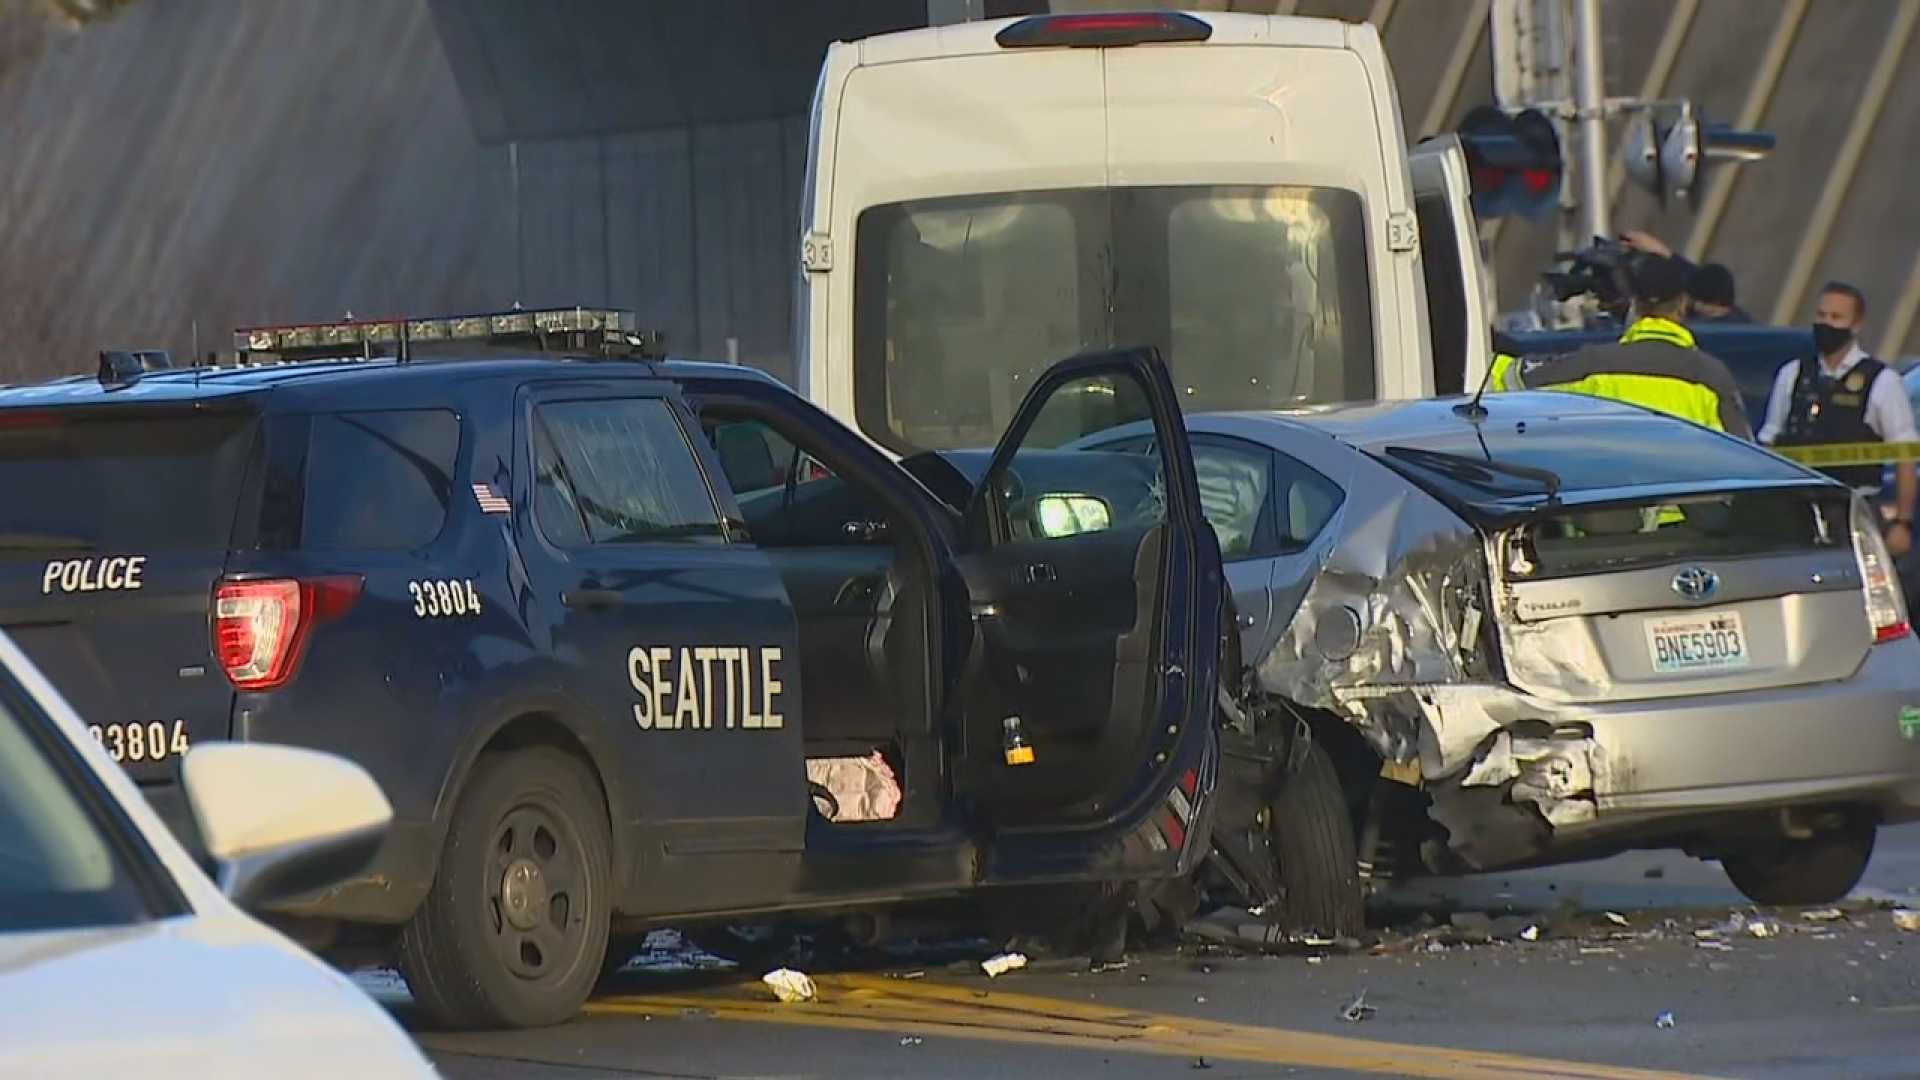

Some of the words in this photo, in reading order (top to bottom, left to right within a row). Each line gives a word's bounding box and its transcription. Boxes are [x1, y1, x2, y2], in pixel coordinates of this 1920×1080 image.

[43, 557, 147, 594] POLICE
[408, 578, 482, 618] 33804
[1655, 630, 1742, 663] BNE5903
[627, 646, 785, 729] SEATTLE
